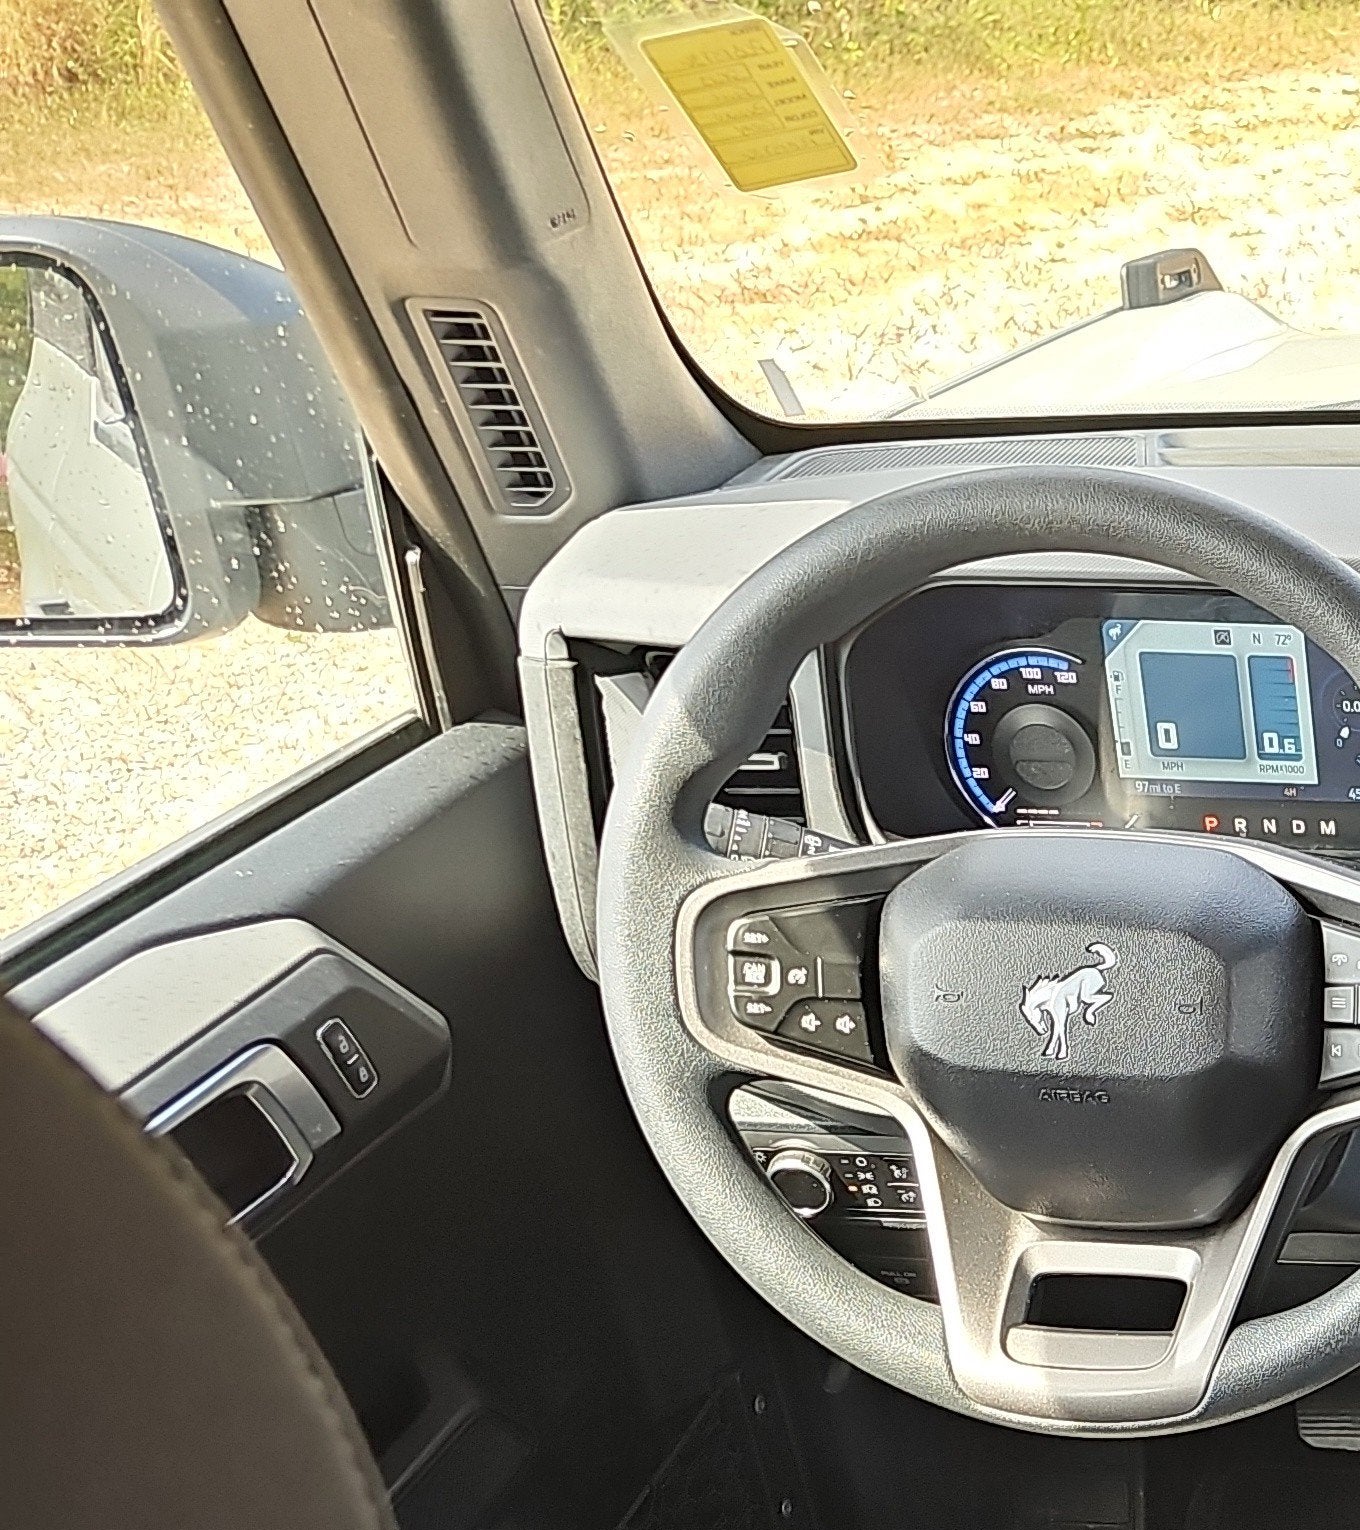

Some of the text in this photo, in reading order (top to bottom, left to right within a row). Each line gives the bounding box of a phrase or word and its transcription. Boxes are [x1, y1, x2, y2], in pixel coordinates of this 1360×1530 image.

[1253, 634, 1292, 645] N 72°
[1020, 668, 1041, 679] 100
[1054, 672, 1077, 683] 120
[991, 678, 1007, 689] 80
[1028, 685, 1054, 694] MPH
[970, 702, 986, 712] 60
[1342, 700, 1360, 713] 0.0
[964, 734, 980, 744] 40
[1156, 722, 1179, 750] 0
[1262, 732, 1295, 754] 0.6
[1336, 739, 1343, 748] 0
[1162, 762, 1184, 771] MPH
[972, 768, 989, 778] 20
[1283, 787, 1297, 797] 4H
[1205, 817, 1336, 835] P R N D M
[1039, 1089, 1109, 1104] AIRBAG
